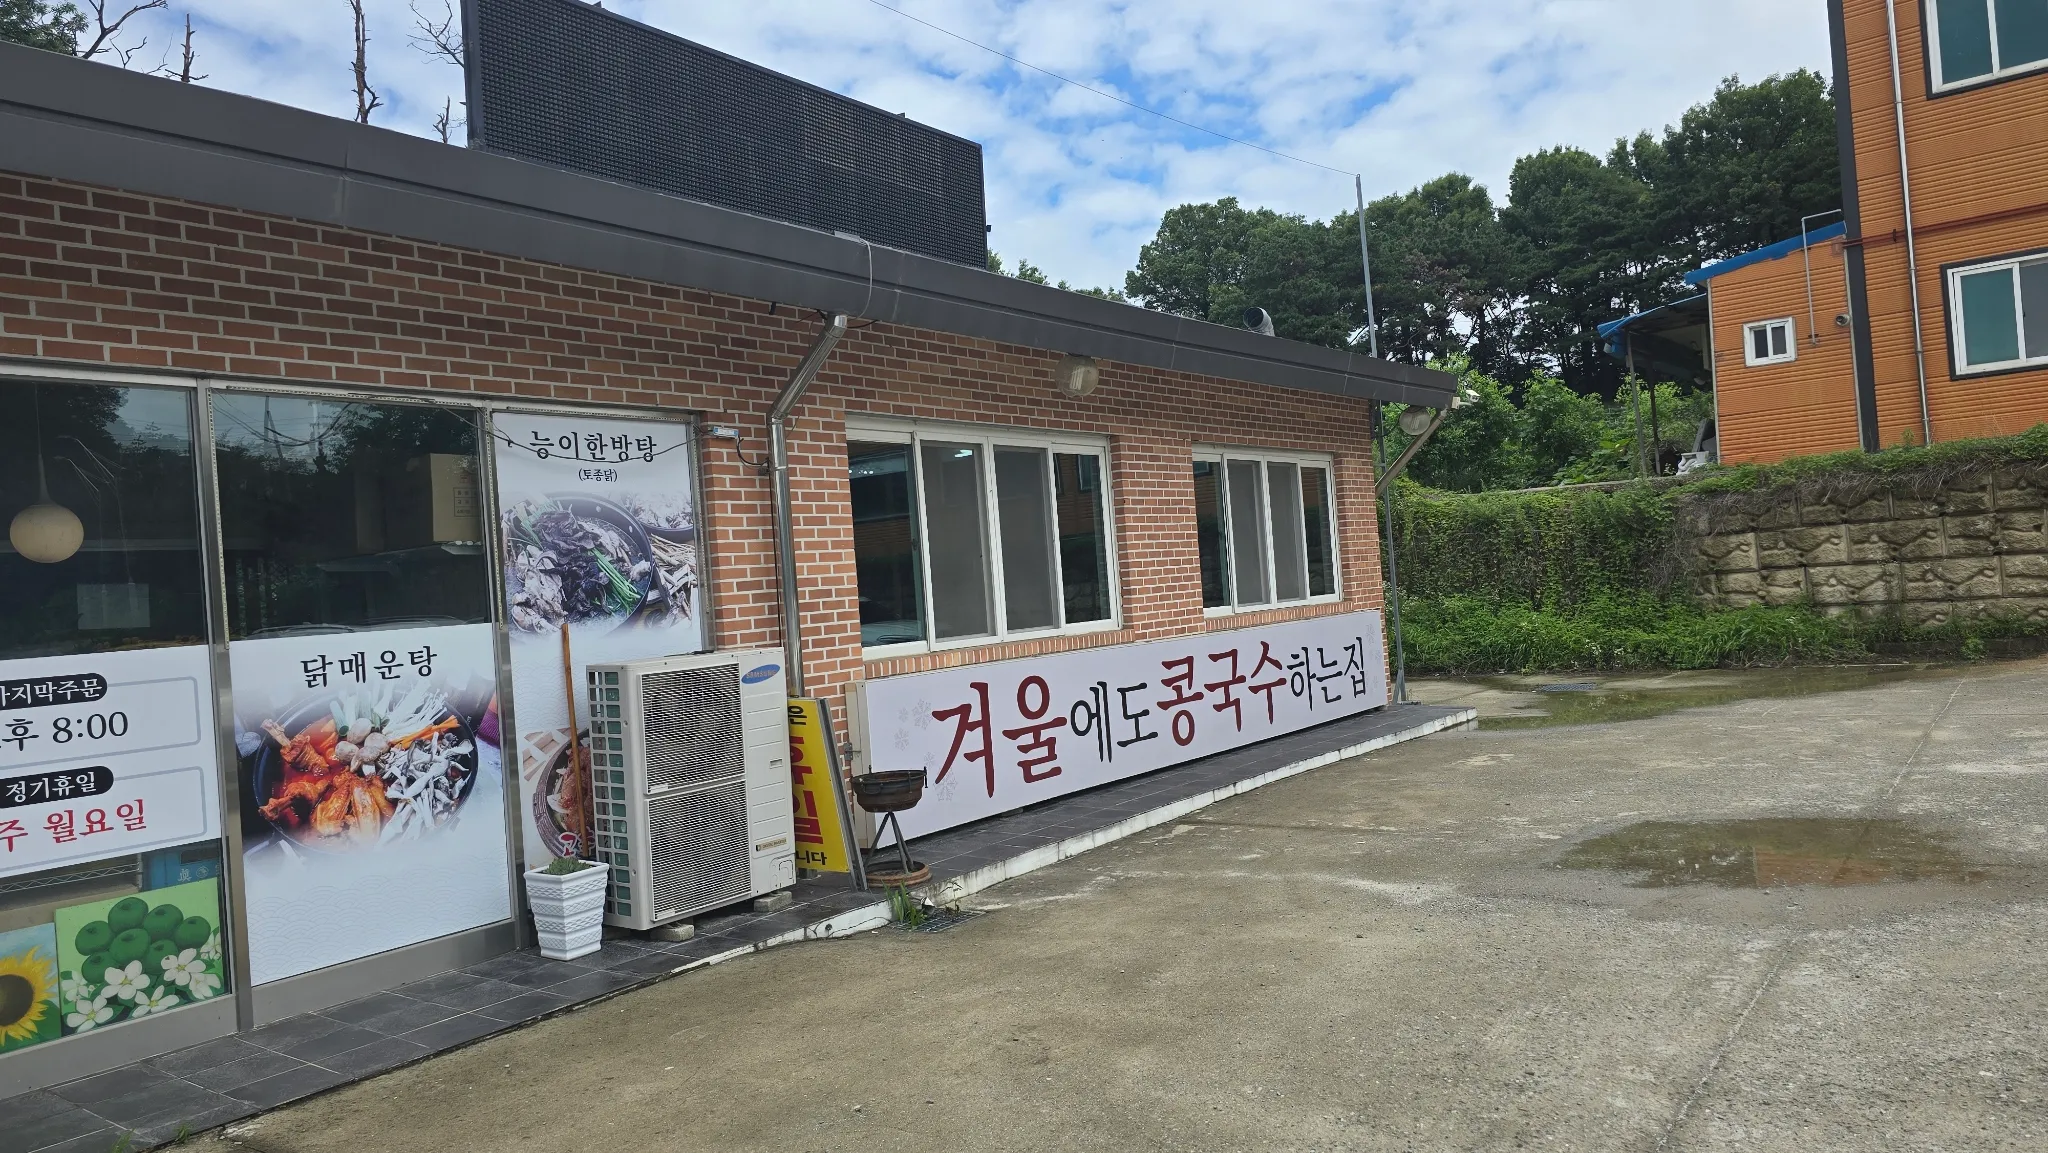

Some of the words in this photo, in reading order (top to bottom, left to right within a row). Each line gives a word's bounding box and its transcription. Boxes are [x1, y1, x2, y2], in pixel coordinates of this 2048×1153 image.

[529, 430, 657, 463] 능이한방탕
[578, 468, 618, 482] (토종닭)
[300, 645, 437, 688] 닭매운탕
[52, 711, 129, 744] 8:00
[6, 771, 97, 803] 정기휴일
[43, 799, 147, 844] 월요일
